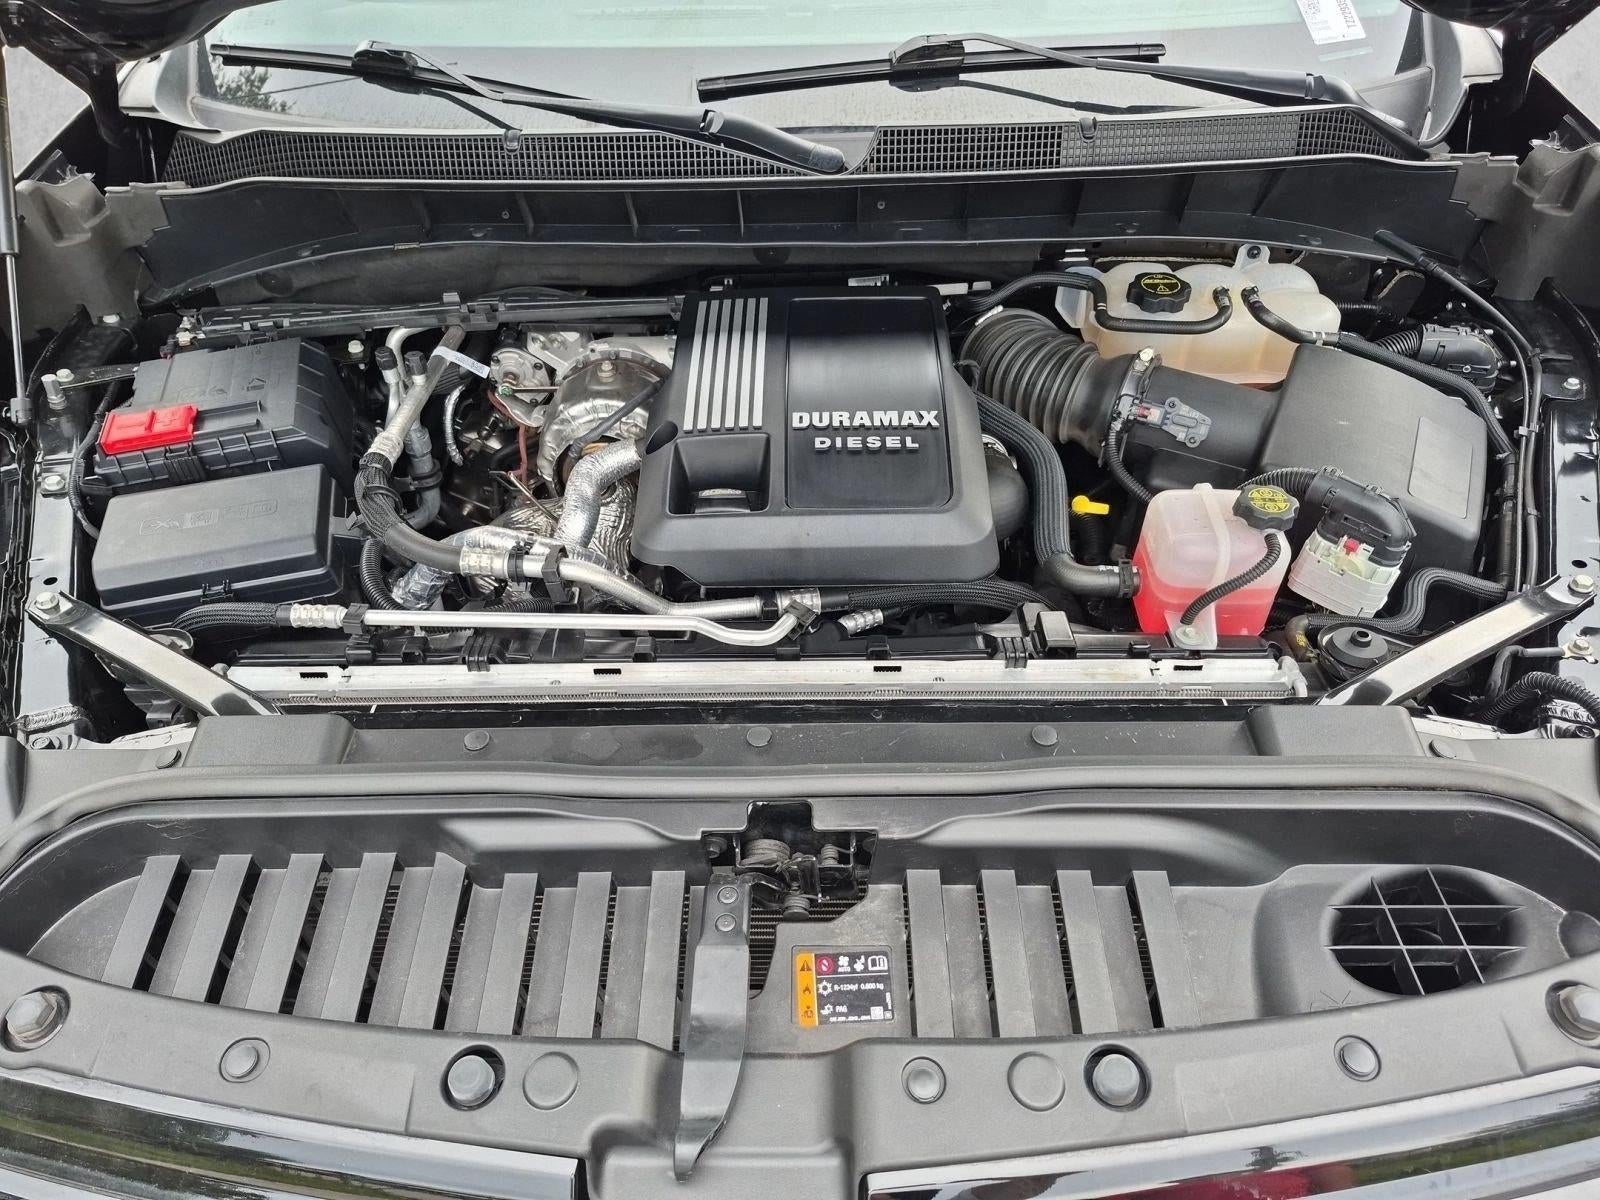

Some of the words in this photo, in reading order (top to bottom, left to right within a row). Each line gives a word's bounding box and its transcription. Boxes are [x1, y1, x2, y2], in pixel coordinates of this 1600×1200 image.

[792, 410, 940, 429] DURAMAX
[814, 436, 920, 449] DIESEL
[835, 1005, 848, 1013] PAG
